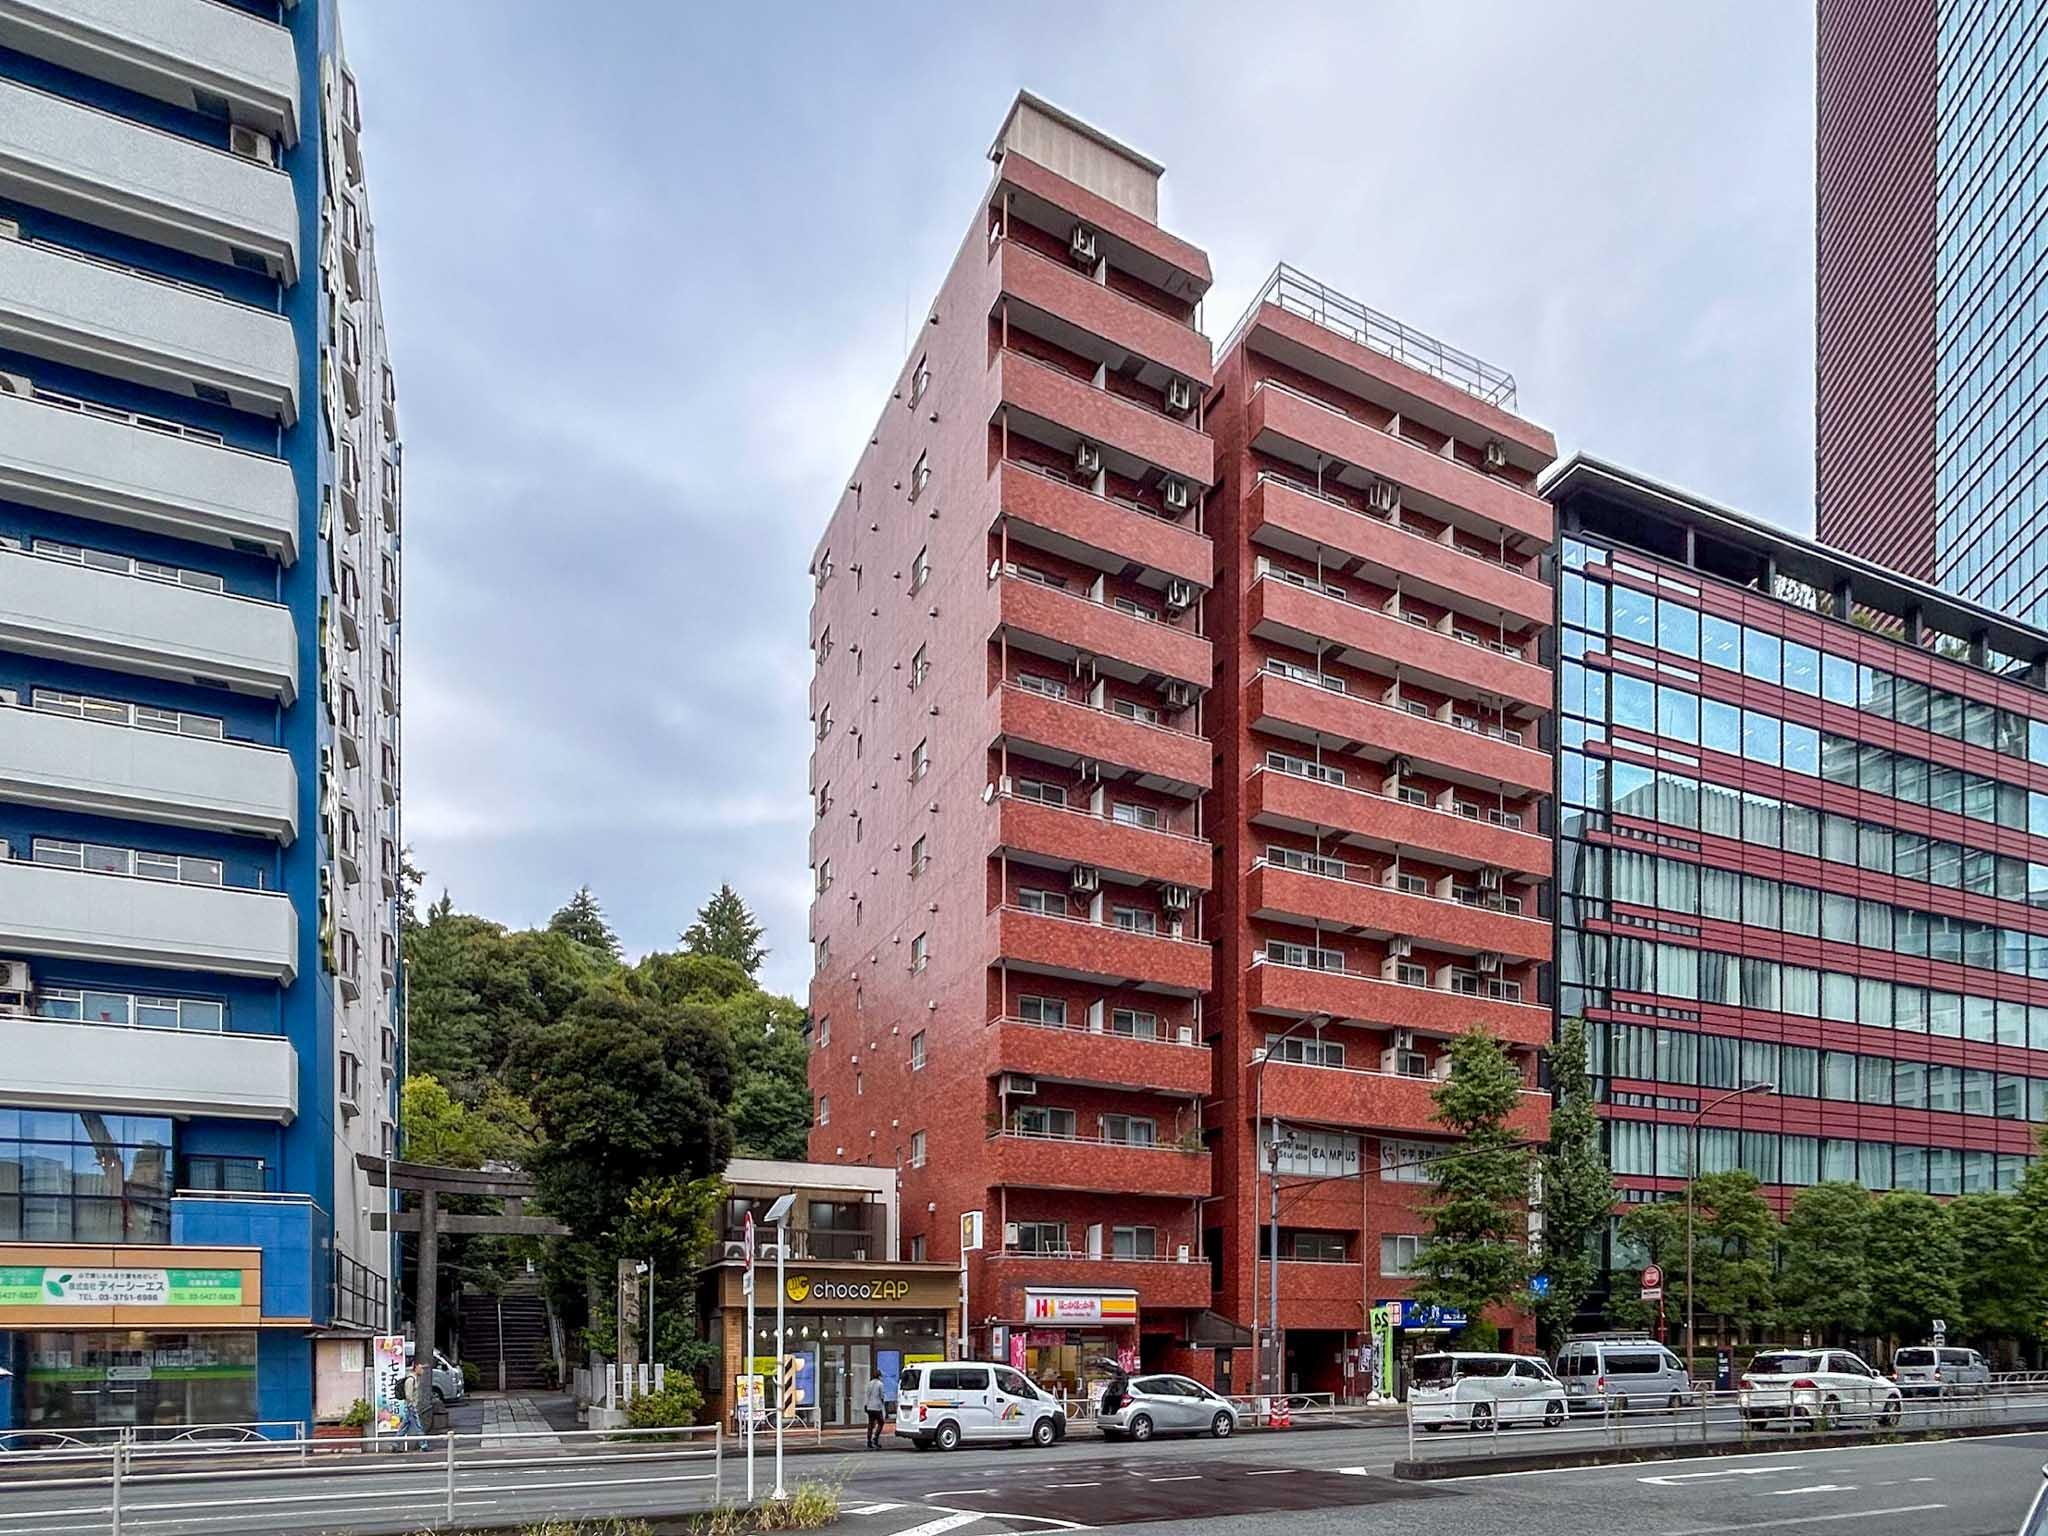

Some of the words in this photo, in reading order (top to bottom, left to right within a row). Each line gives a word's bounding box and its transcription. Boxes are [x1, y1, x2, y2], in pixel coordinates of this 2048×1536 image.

[1311, 1147, 1356, 1162] CAMPUS
[99, 1281, 165, 1291] ティーシーエス
[813, 1279, 909, 1299] chocoZAP
